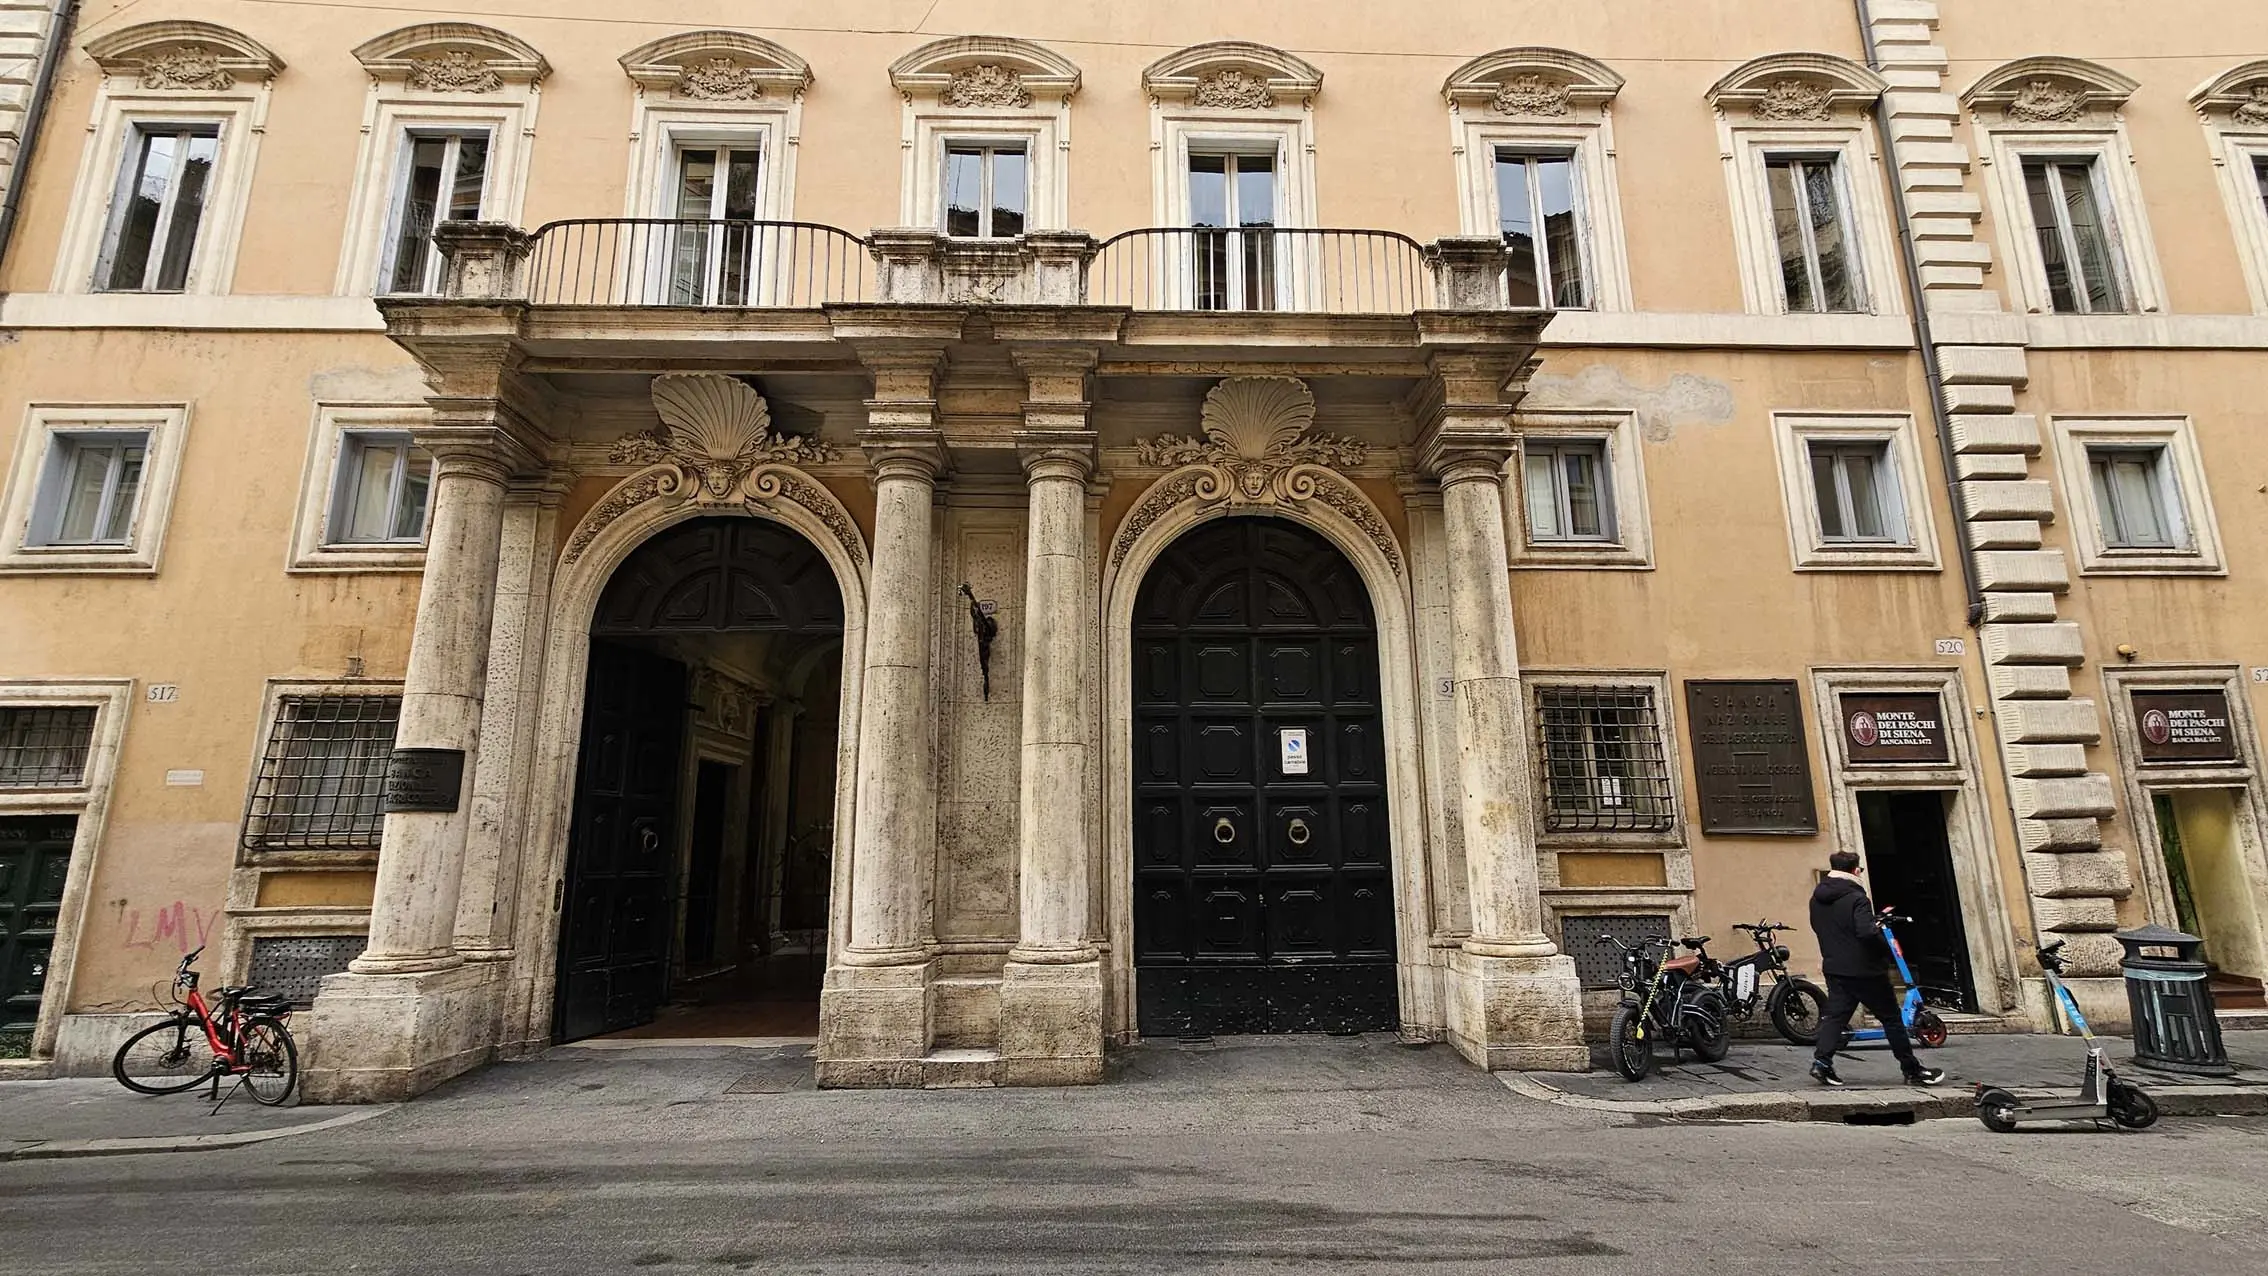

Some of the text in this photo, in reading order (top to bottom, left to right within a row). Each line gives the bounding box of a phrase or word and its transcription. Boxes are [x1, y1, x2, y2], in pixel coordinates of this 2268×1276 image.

[1938, 641, 1963, 653] 520
[2254, 669, 2268, 682] 52
[1441, 681, 1454, 693] 51
[149, 686, 177, 700] 517
[1876, 711, 1916, 720] MONTE
[2168, 710, 2206, 718] MONTE
[1878, 721, 1936, 729] DEI PASCHI
[2170, 719, 2225, 727] DEI PASCHI
[1880, 730, 1926, 738] DI SIENA
[2171, 728, 2216, 736] DI SIENA
